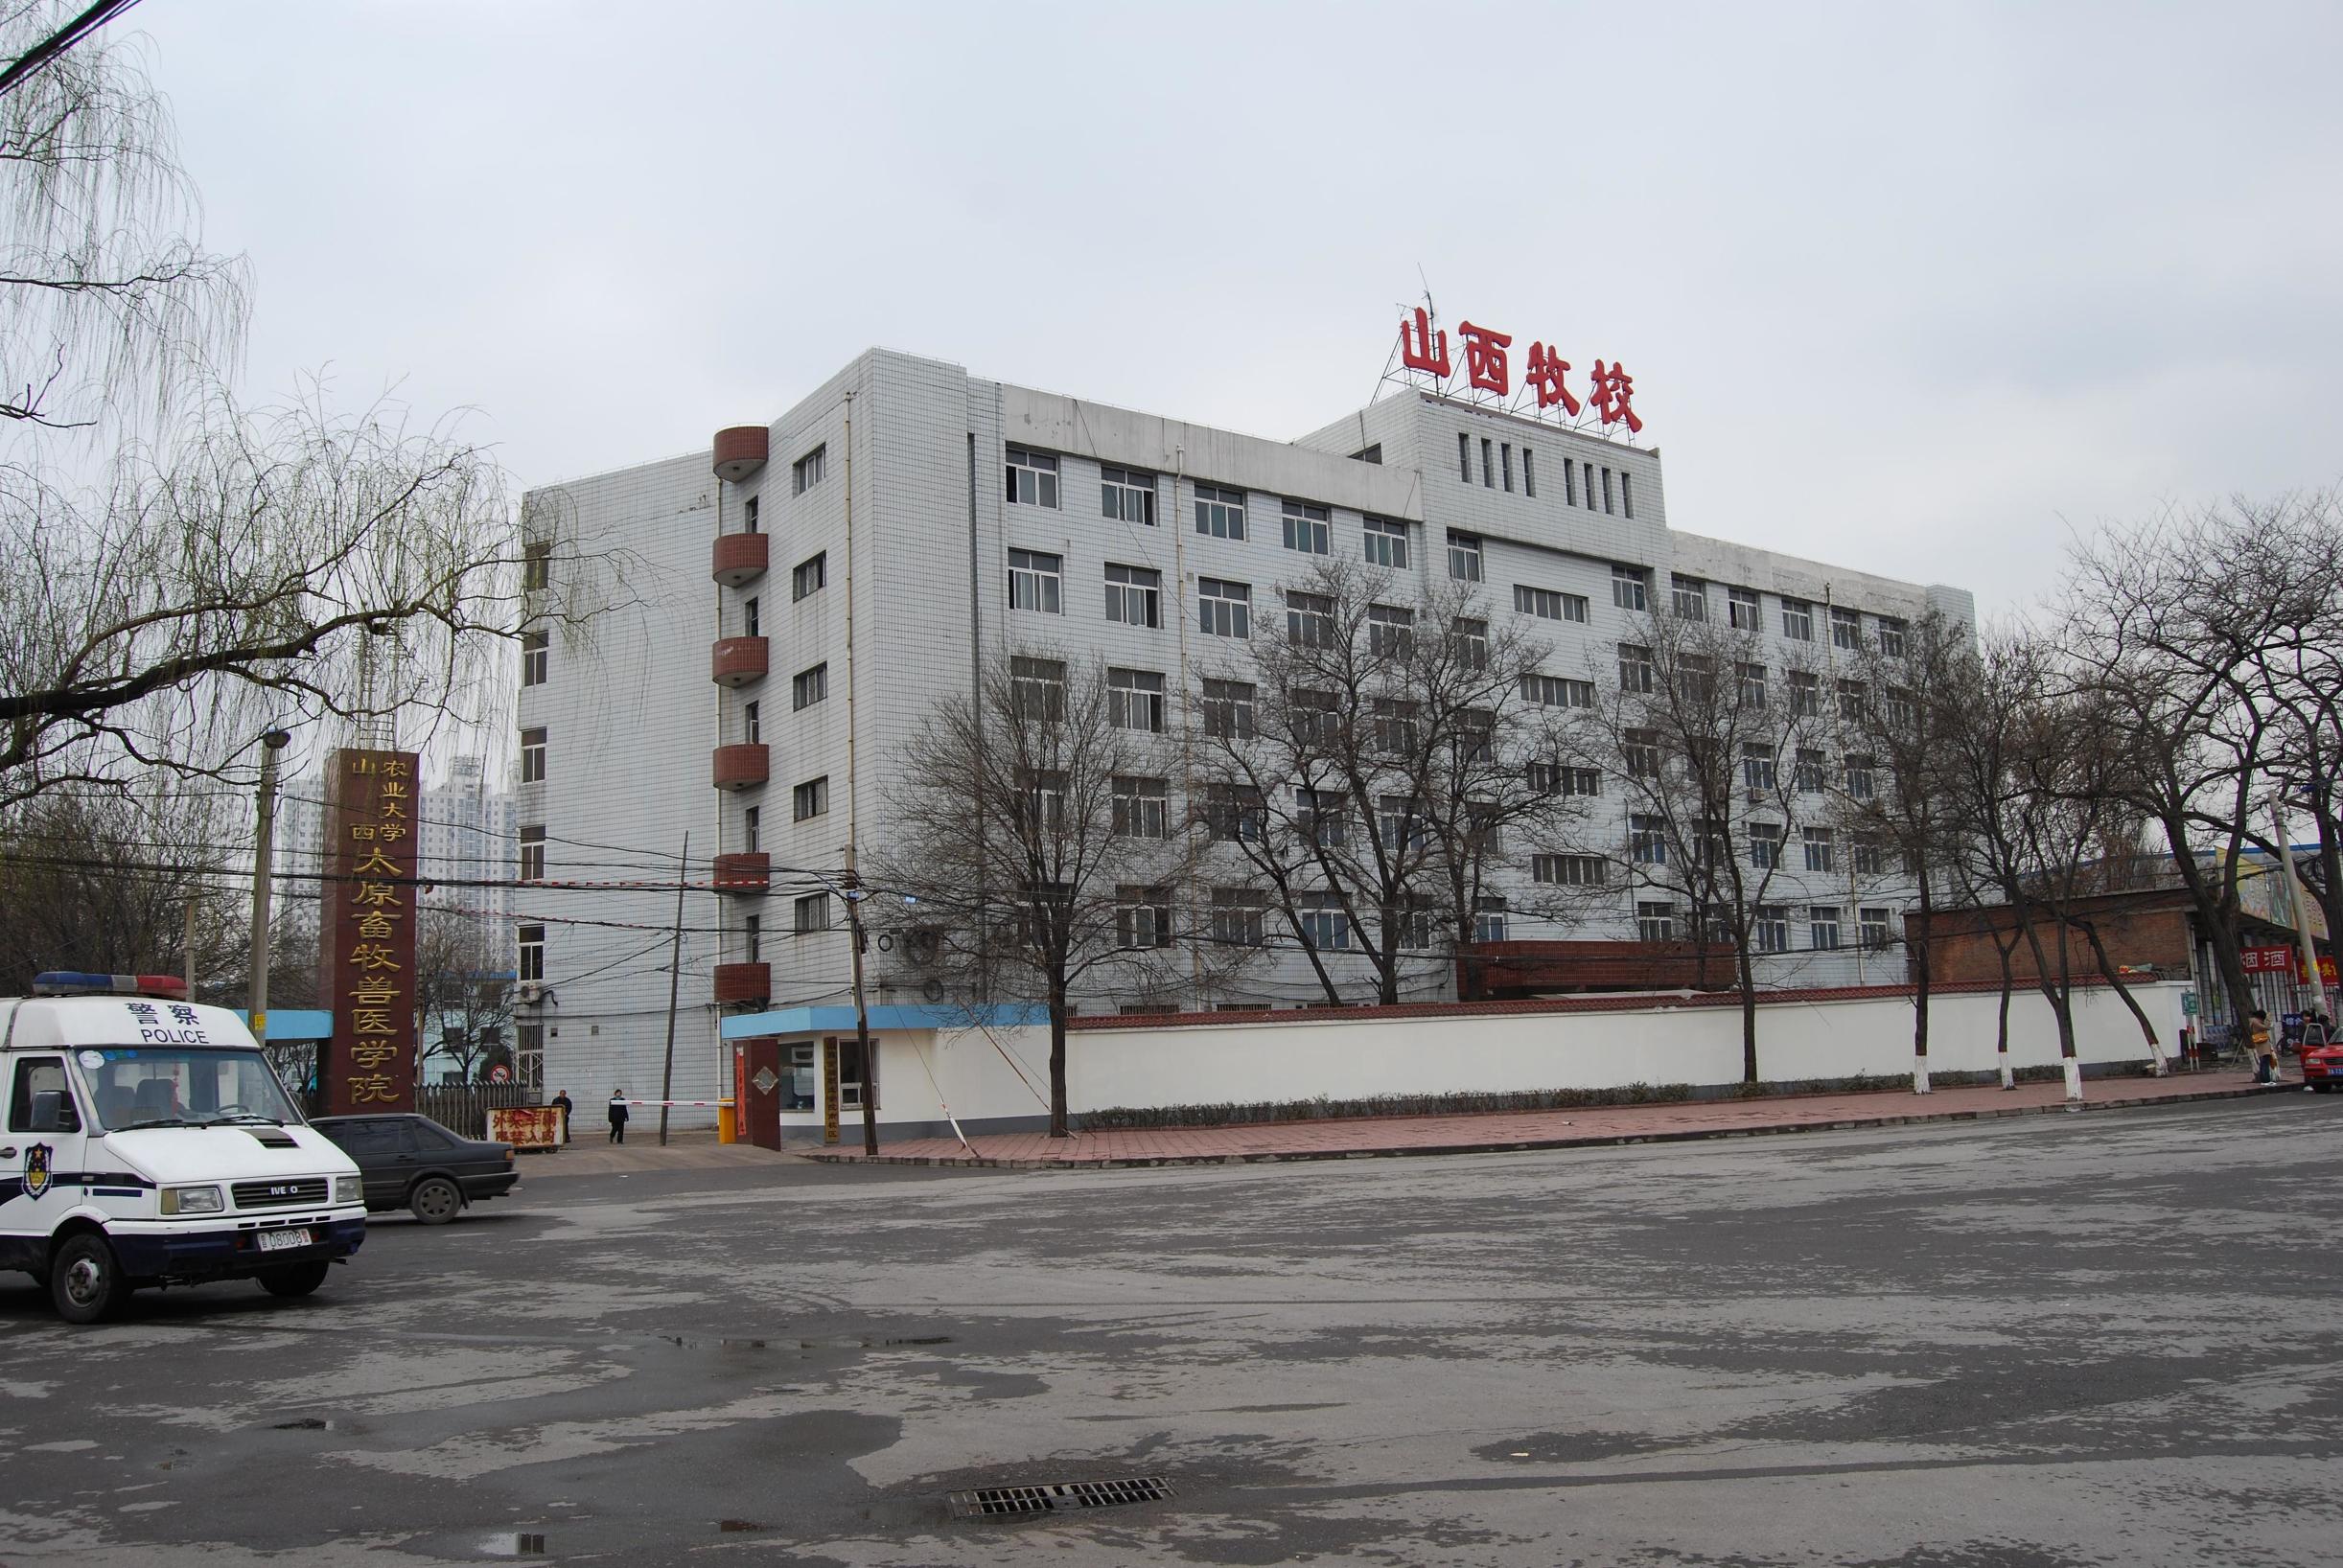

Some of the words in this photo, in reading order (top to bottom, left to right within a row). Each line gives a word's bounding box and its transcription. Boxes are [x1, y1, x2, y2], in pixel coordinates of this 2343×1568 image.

[1401, 306, 1643, 432] 山西牧校
[380, 759, 409, 842] 农业大学
[126, 1003, 200, 1026] 警察
[347, 846, 403, 1105] 太原畜牧兽医学院
[141, 1028, 210, 1045] POLICE
